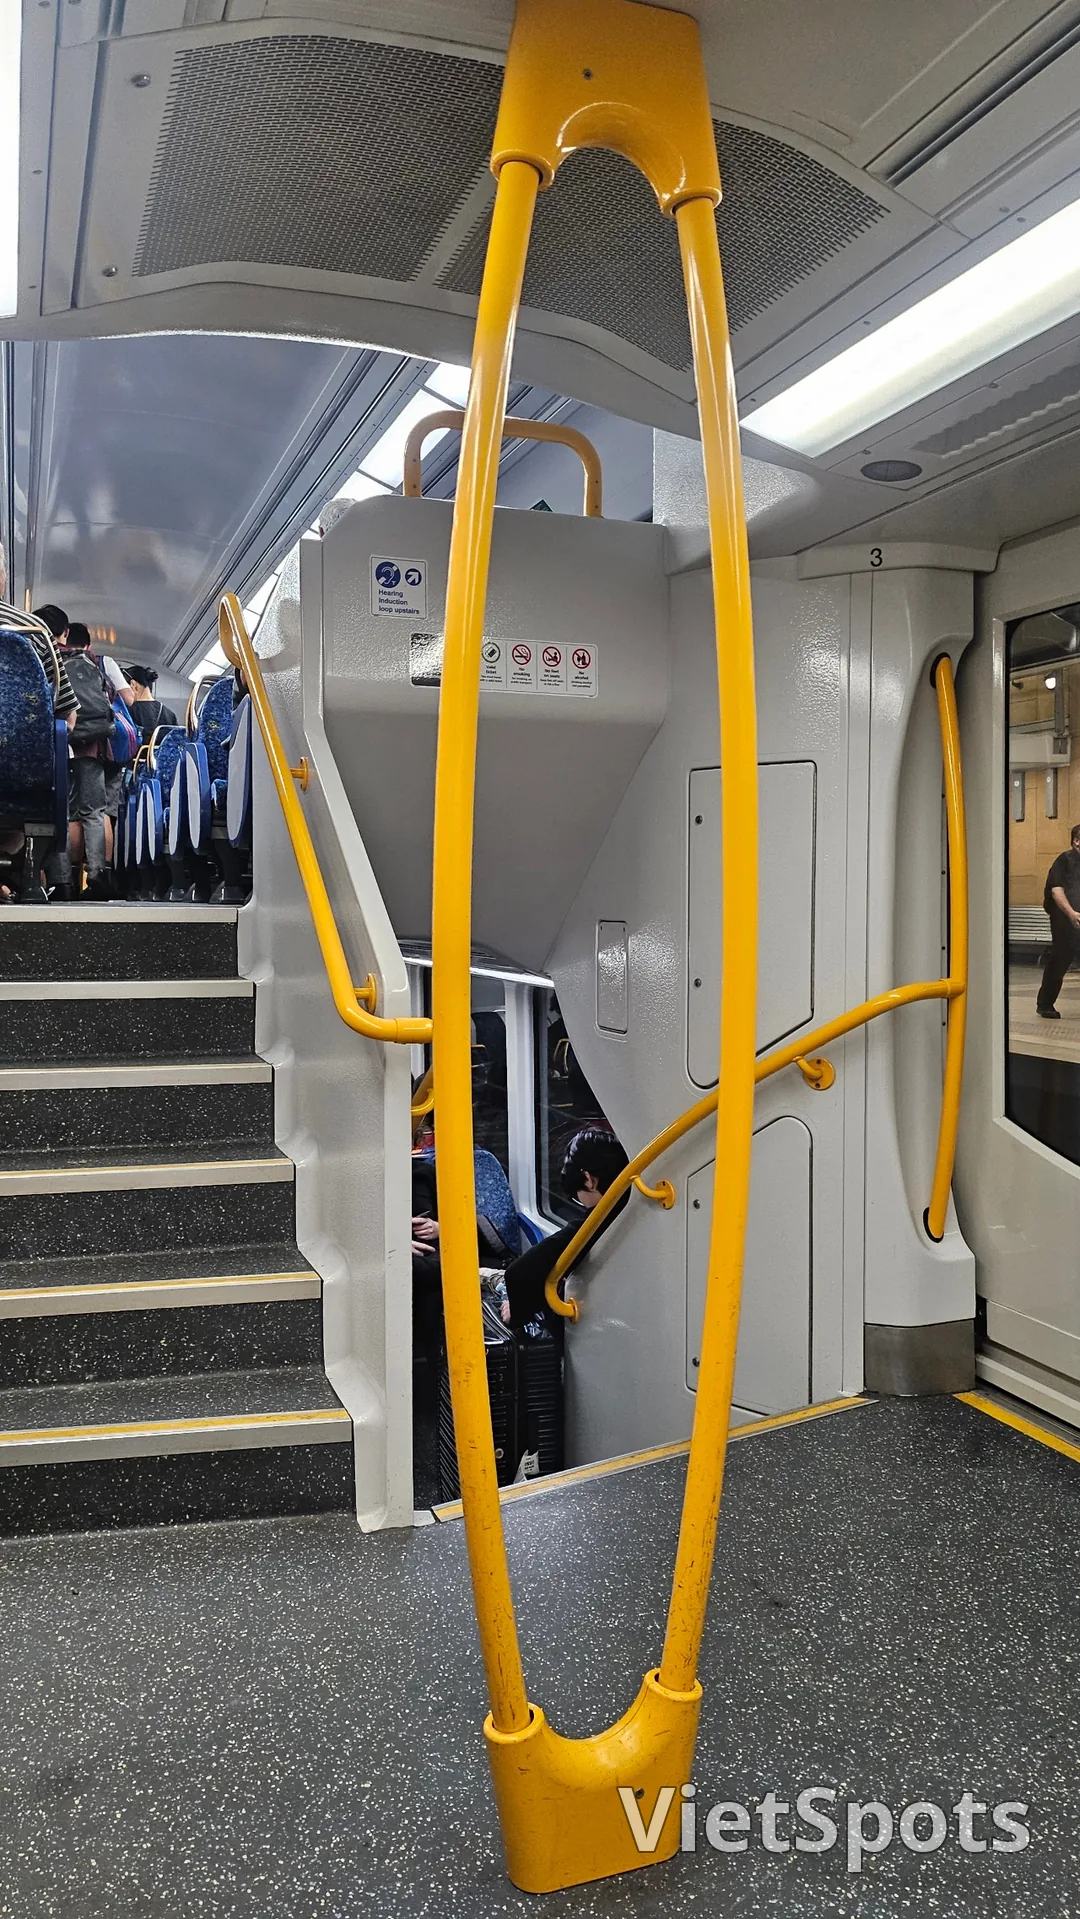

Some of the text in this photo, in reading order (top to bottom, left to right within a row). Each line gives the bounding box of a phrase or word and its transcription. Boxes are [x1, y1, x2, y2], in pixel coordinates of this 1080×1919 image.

[870, 547, 883, 567] 3
[378, 589, 404, 598] Hearing
[378, 605, 420, 615] loop upstairs
